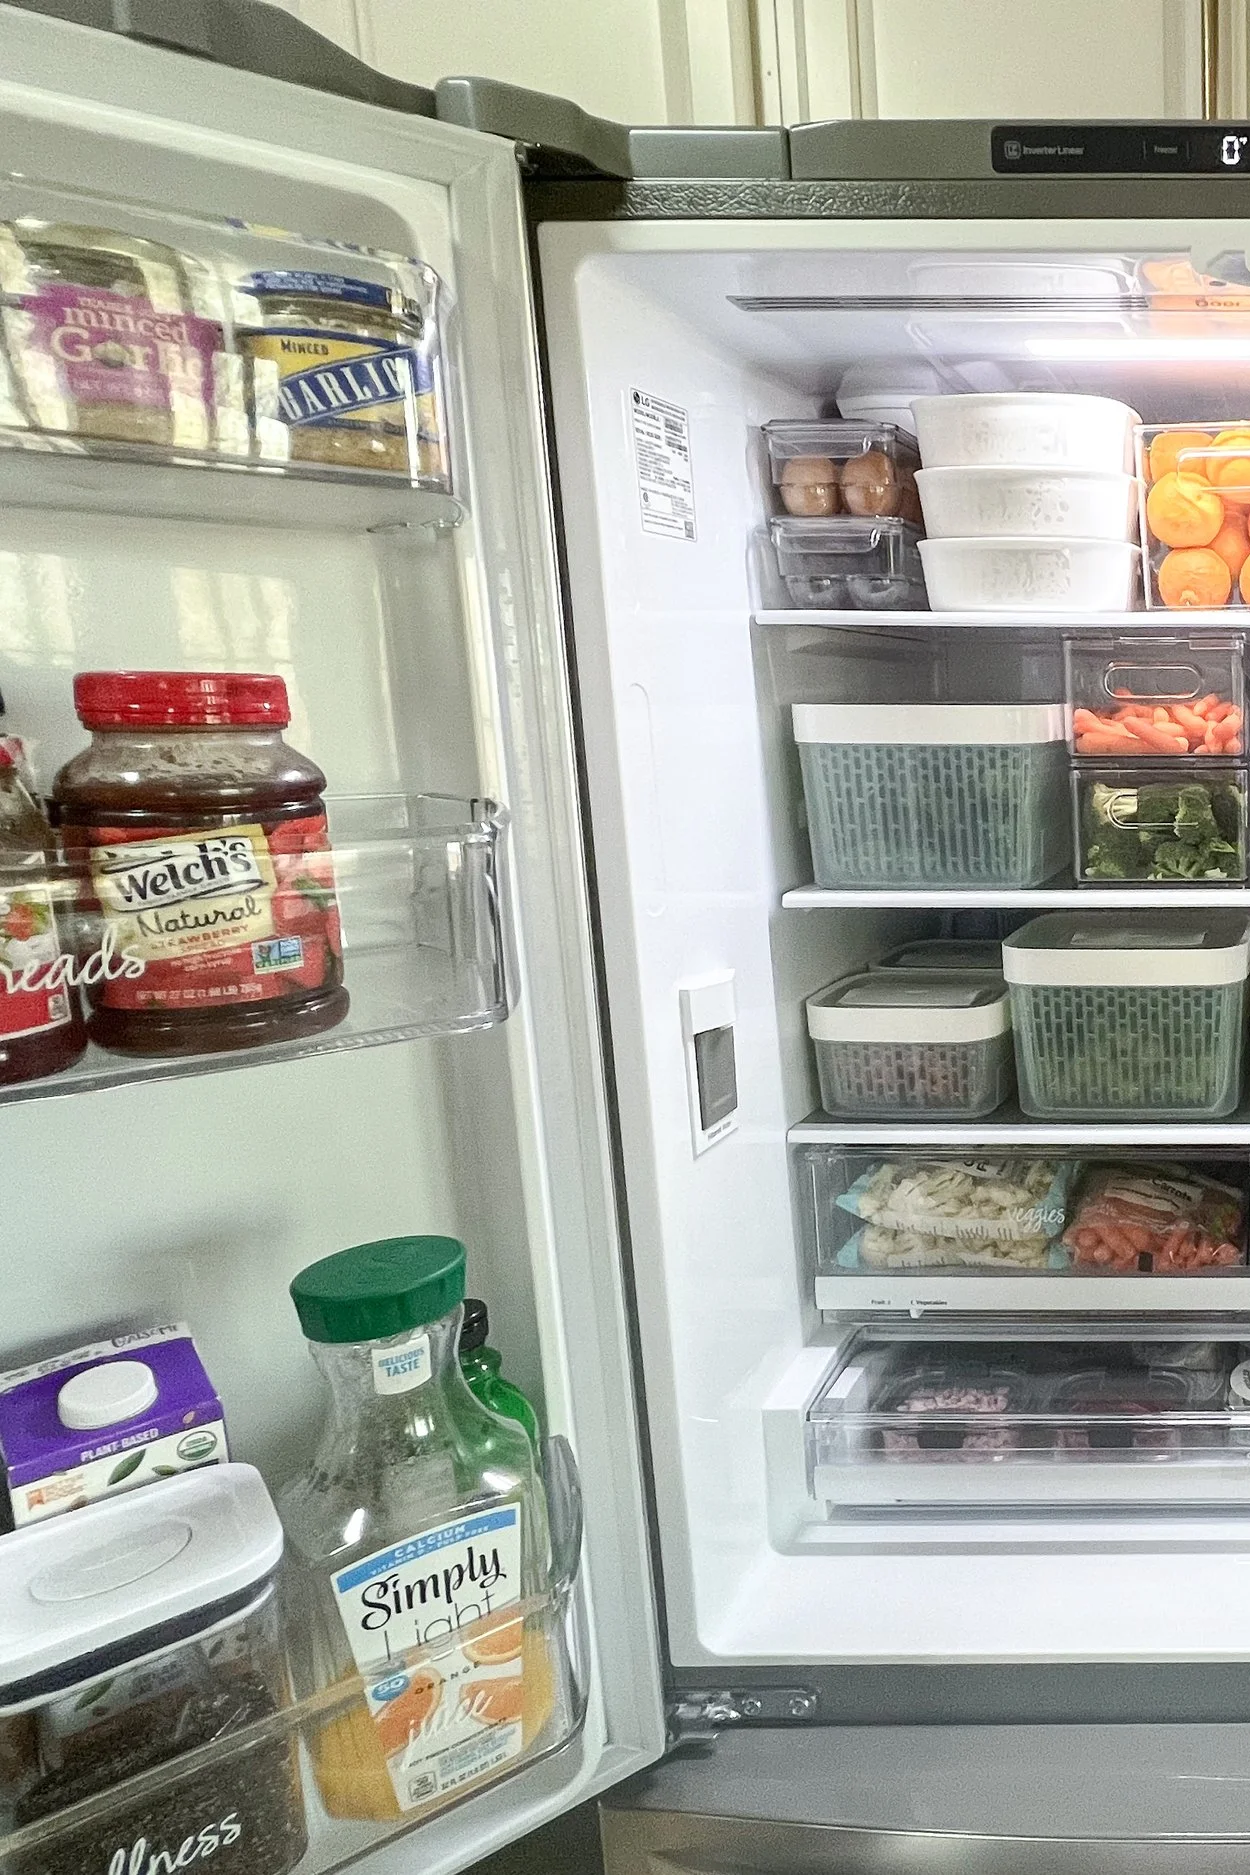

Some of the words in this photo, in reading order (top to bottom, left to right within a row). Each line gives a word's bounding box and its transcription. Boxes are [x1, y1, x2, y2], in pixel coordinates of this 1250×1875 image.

[63, 306, 190, 345] minced
[50, 325, 203, 377] Grlic
[278, 356, 406, 421] GARLIC
[112, 851, 252, 903] Welch's
[136, 895, 263, 937] Natural
[1152, 1179, 1193, 1202] Carrots
[1006, 1207, 1066, 1233] veggies
[378, 1347, 425, 1368] DELICIOUS
[385, 1358, 420, 1378] TASTE
[80, 1427, 159, 1462] PLANT-BASED
[394, 1524, 467, 1558] CALCIUM
[361, 1546, 508, 1630] Simply
[415, 1660, 481, 1695] ORANGE
